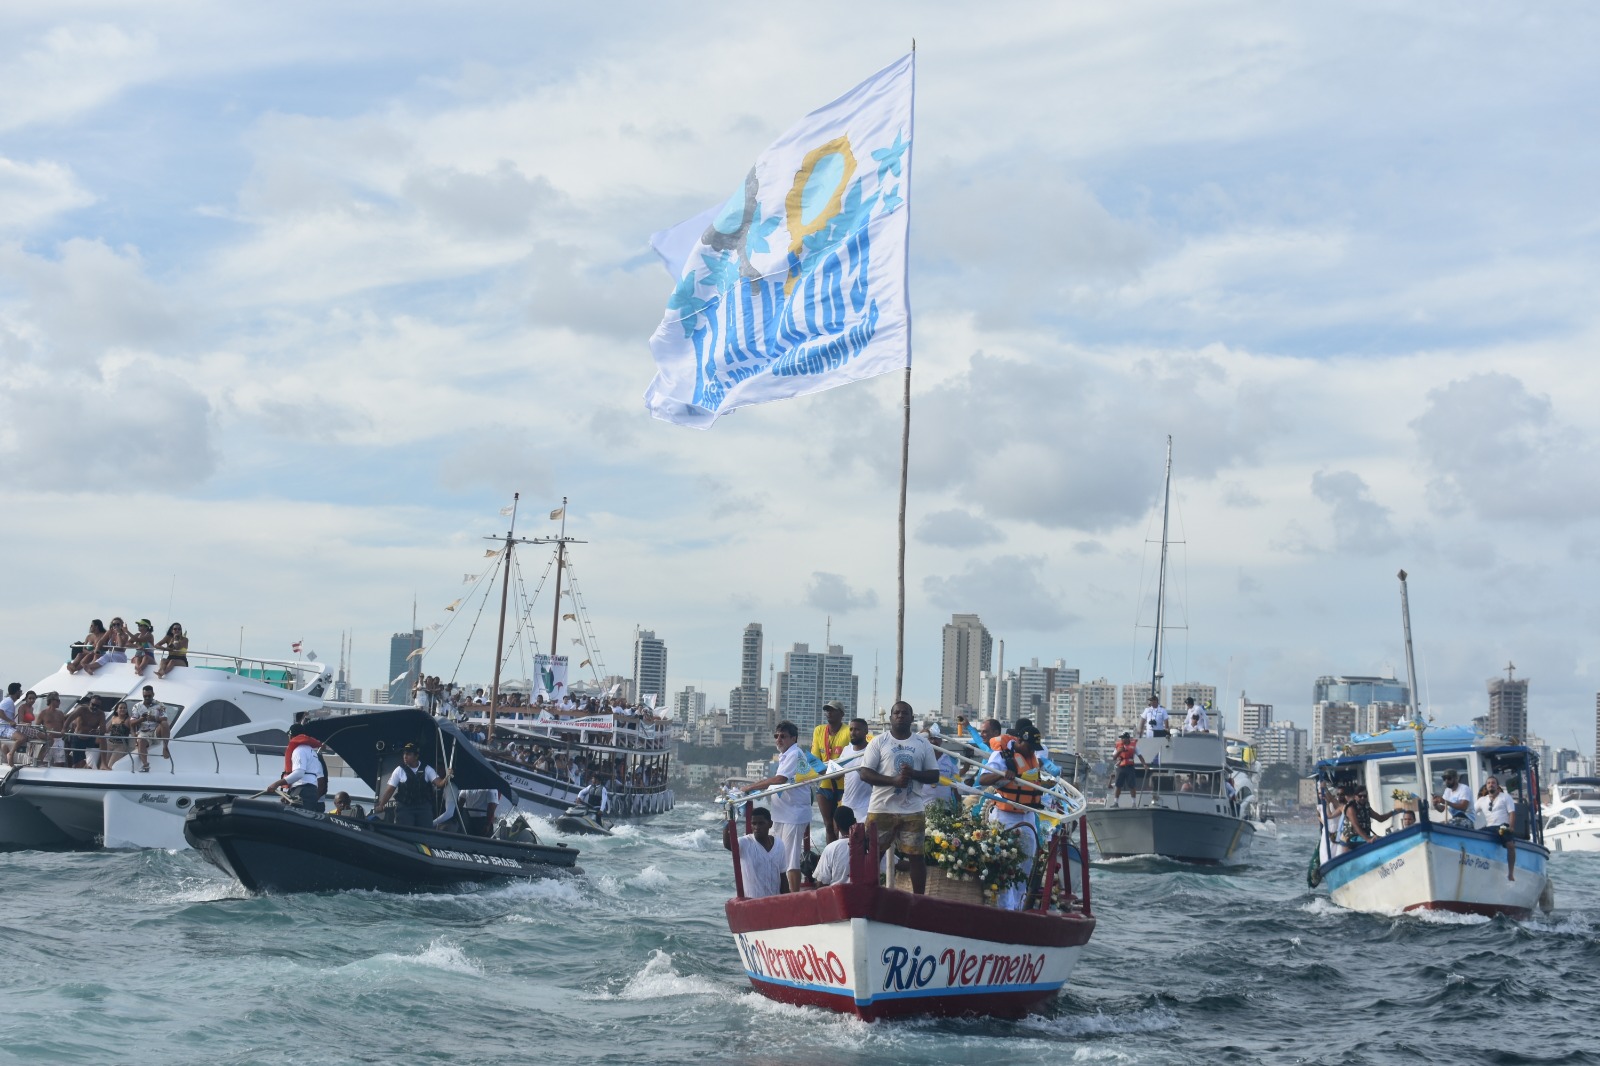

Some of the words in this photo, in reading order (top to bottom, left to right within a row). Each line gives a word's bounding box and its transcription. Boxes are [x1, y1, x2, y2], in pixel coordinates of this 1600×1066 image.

[432, 848, 473, 862] MARINHA
[472, 853, 489, 865] DO
[489, 855, 522, 868] BRASIL
[738, 933, 763, 977] Rio
[755, 939, 847, 985] Vermelho
[882, 945, 936, 992] Rio
[938, 948, 1046, 987] Vermelho
